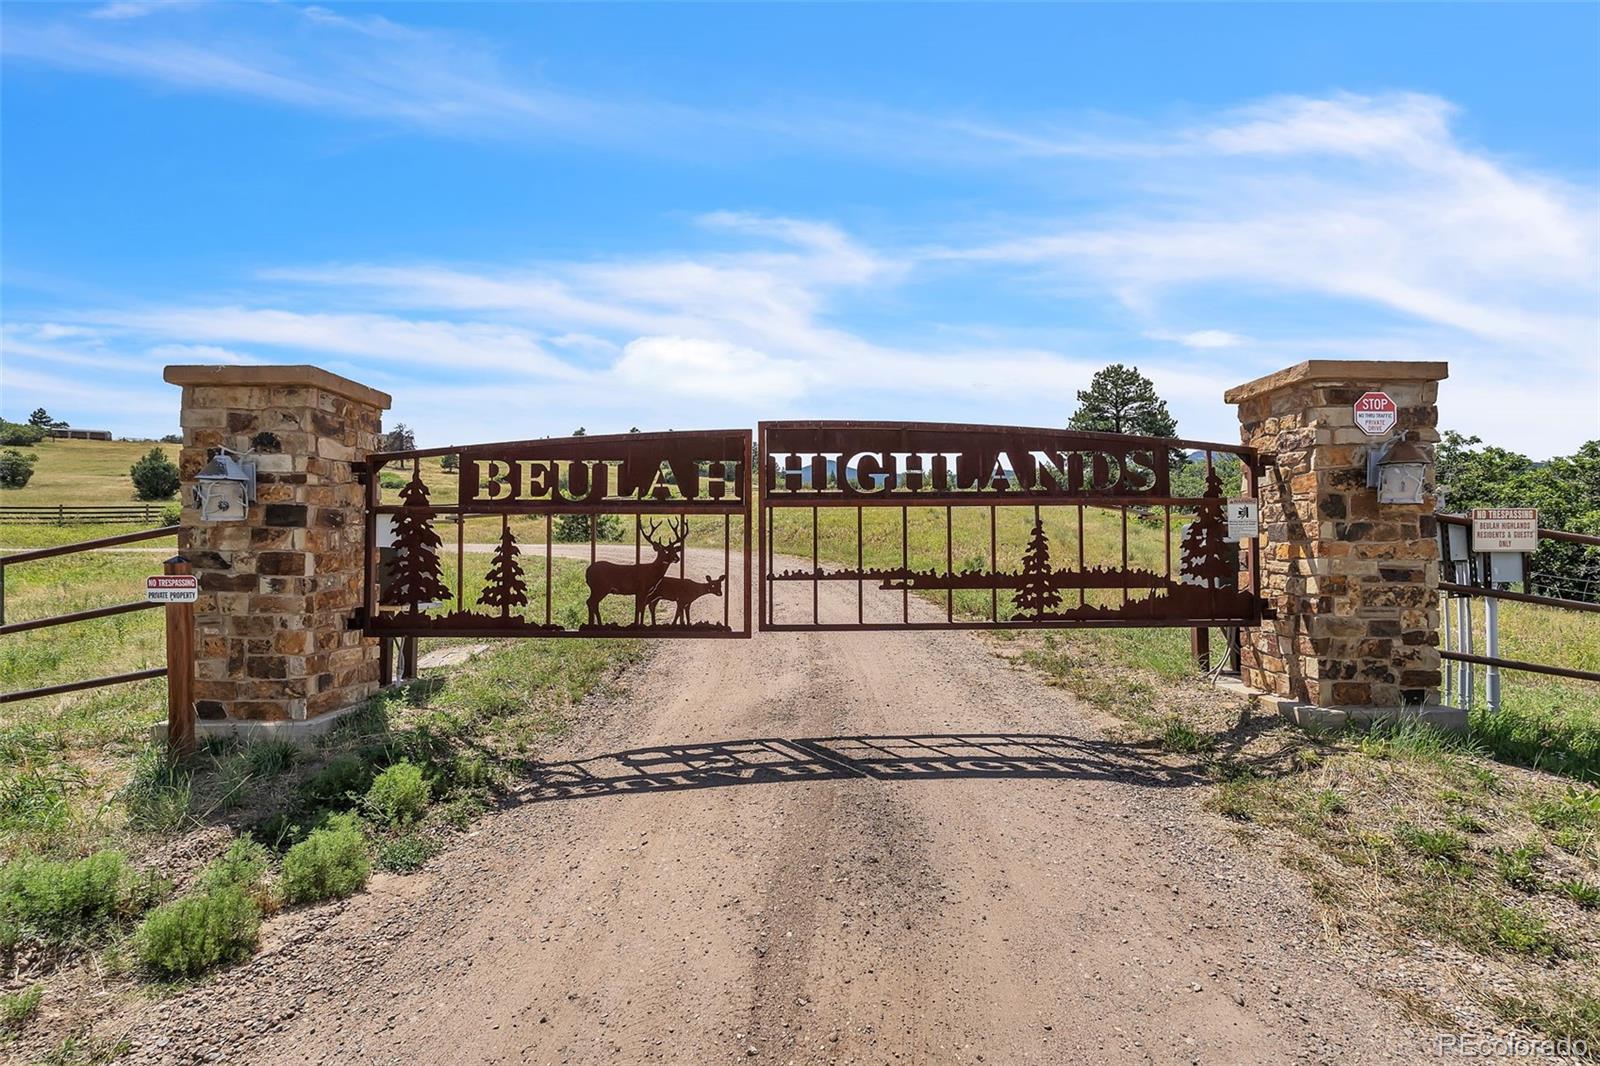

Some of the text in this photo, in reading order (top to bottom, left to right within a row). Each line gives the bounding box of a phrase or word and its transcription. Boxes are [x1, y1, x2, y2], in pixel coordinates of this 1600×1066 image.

[1362, 398, 1388, 410] STOP
[472, 451, 1157, 501] BEULAH HIGHLANDS
[1476, 510, 1534, 519] NO TRESPASSING
[148, 579, 195, 587] NO TRESPASSING
